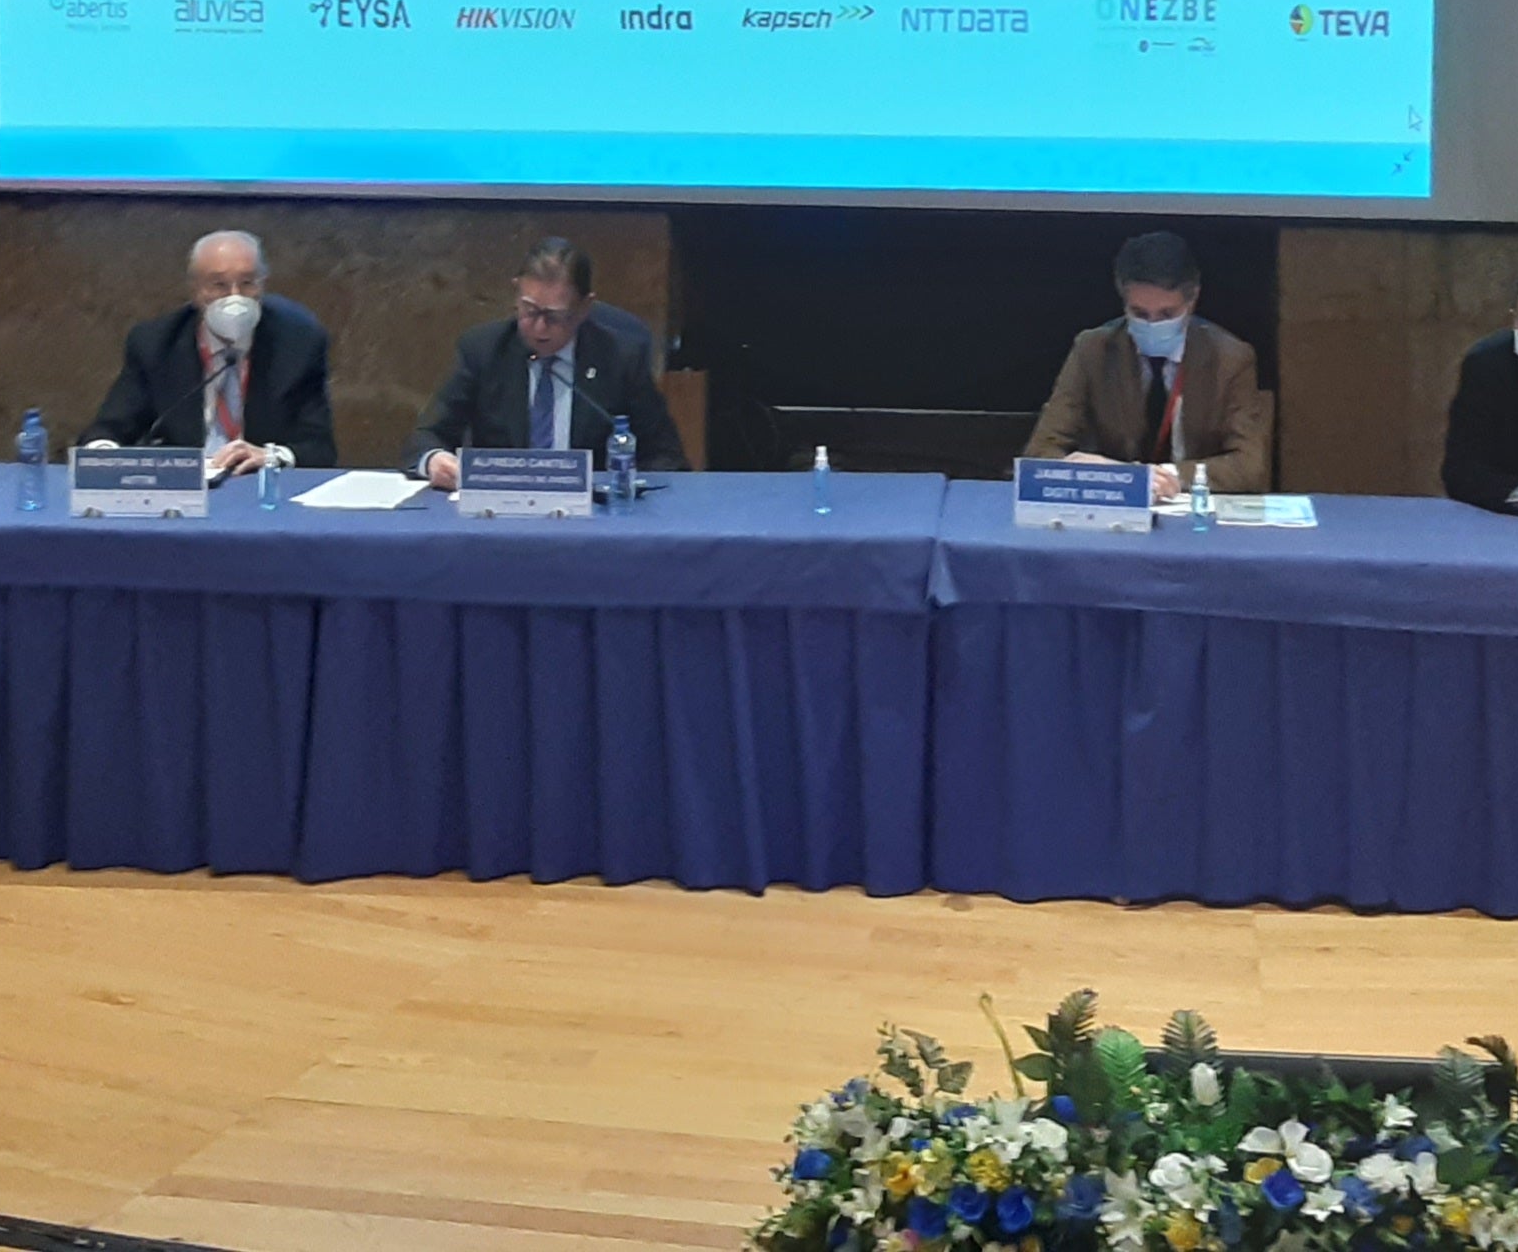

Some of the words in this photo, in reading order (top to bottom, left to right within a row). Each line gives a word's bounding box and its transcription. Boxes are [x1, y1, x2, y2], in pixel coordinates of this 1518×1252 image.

[456, 7, 575, 30] HIKVISION
[620, 5, 694, 30] indra
[742, 8, 832, 32] kapsch
[1318, 9, 1390, 37] TEVA
